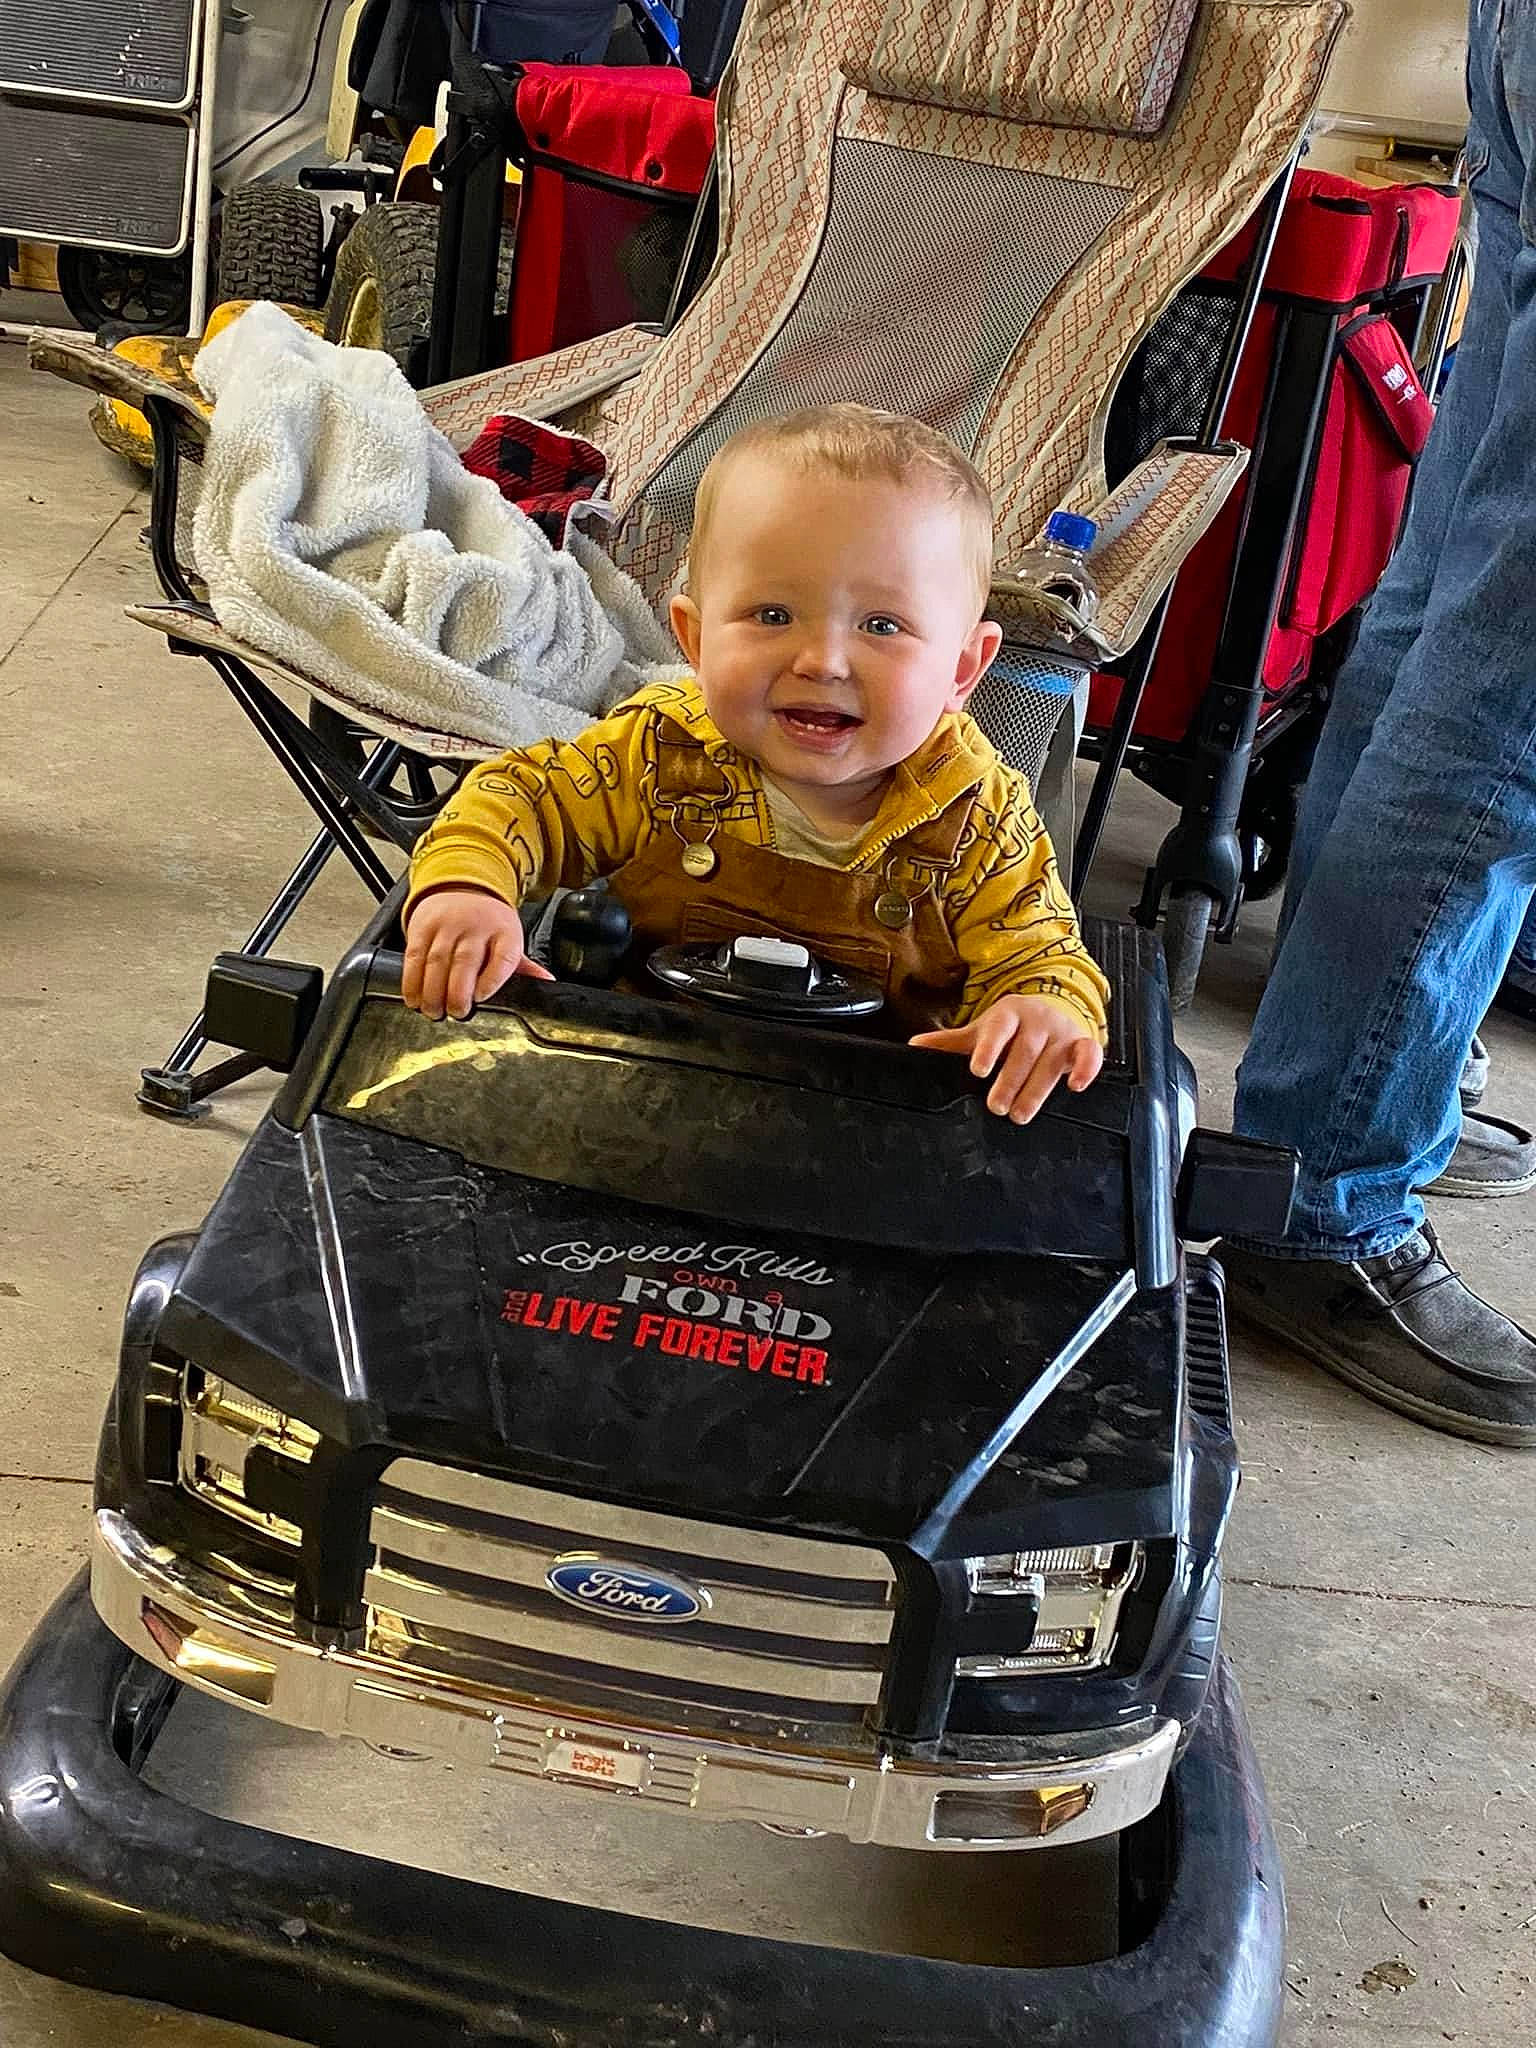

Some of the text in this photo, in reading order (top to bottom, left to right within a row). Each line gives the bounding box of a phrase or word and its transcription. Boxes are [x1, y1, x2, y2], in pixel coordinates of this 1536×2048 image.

[673, 1269, 738, 1294] own
[704, 1245, 833, 1285] Kills
[523, 1292, 623, 1341] LIVE
[617, 1274, 833, 1341] FORD
[577, 1570, 673, 1613] Ford
